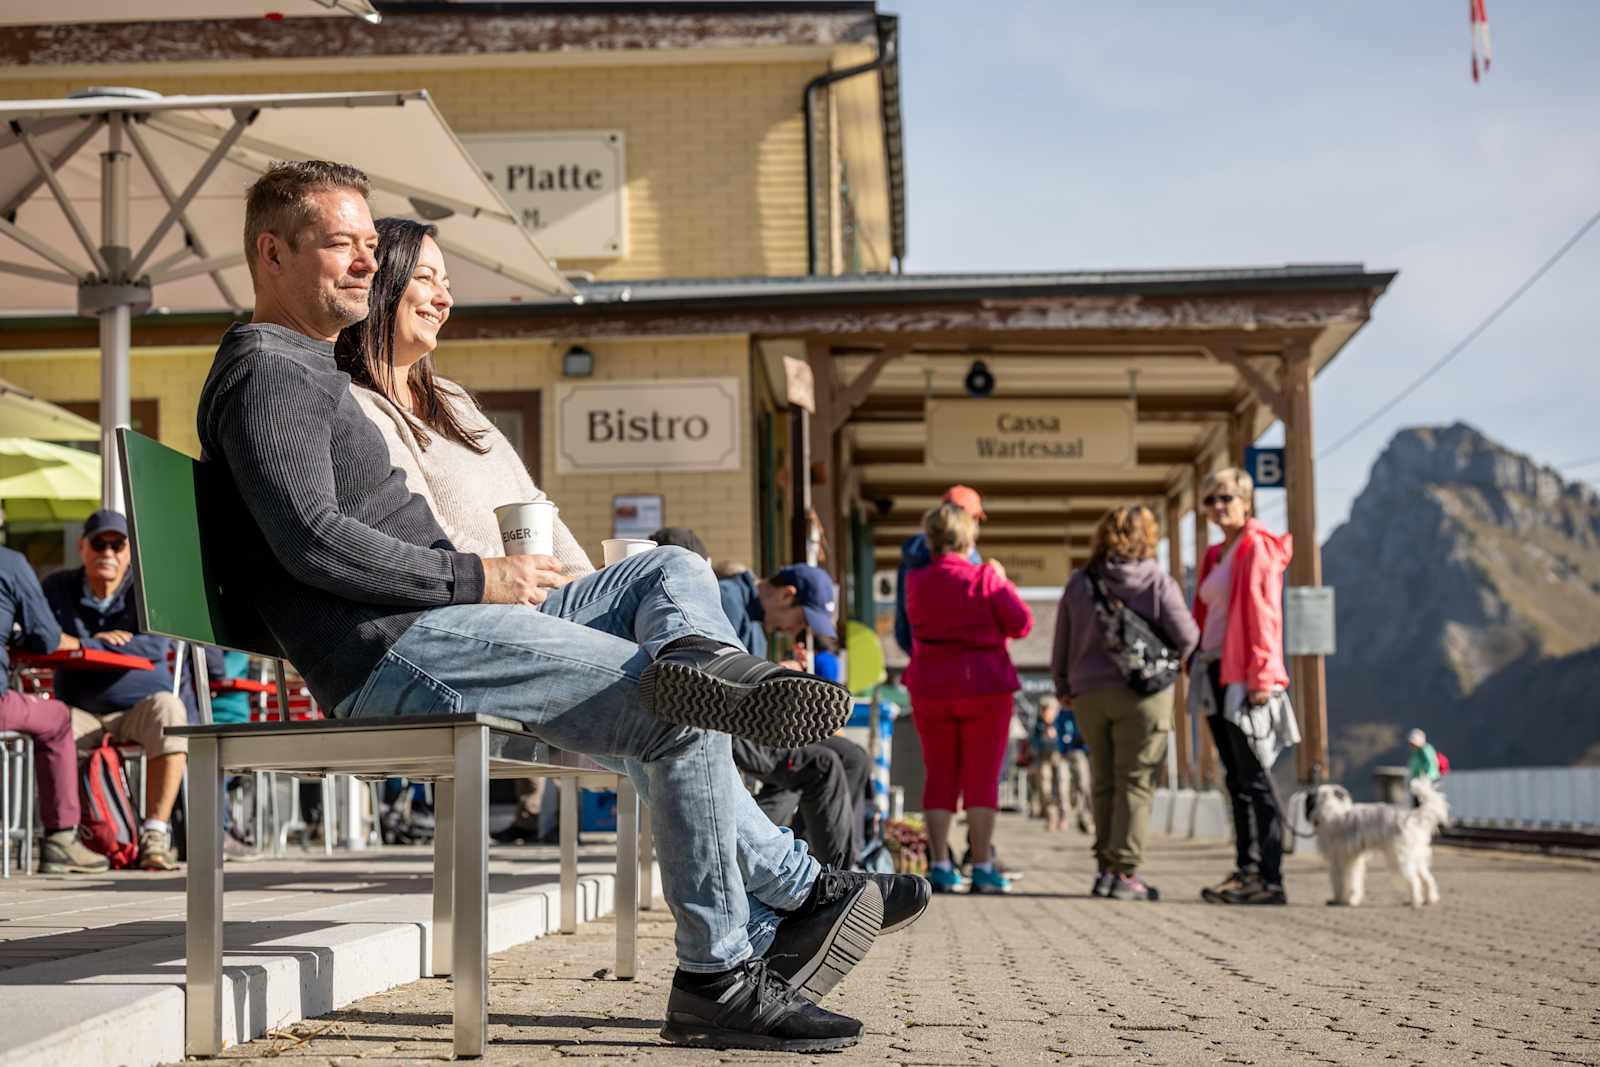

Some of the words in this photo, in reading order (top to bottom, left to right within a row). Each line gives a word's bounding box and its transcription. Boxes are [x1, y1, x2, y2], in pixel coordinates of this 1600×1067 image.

[507, 164, 602, 191] Platte
[588, 409, 709, 443] Bistro
[997, 413, 1061, 433] Cassa
[976, 437, 1084, 458] Wartesaal
[1256, 453, 1282, 484] B
